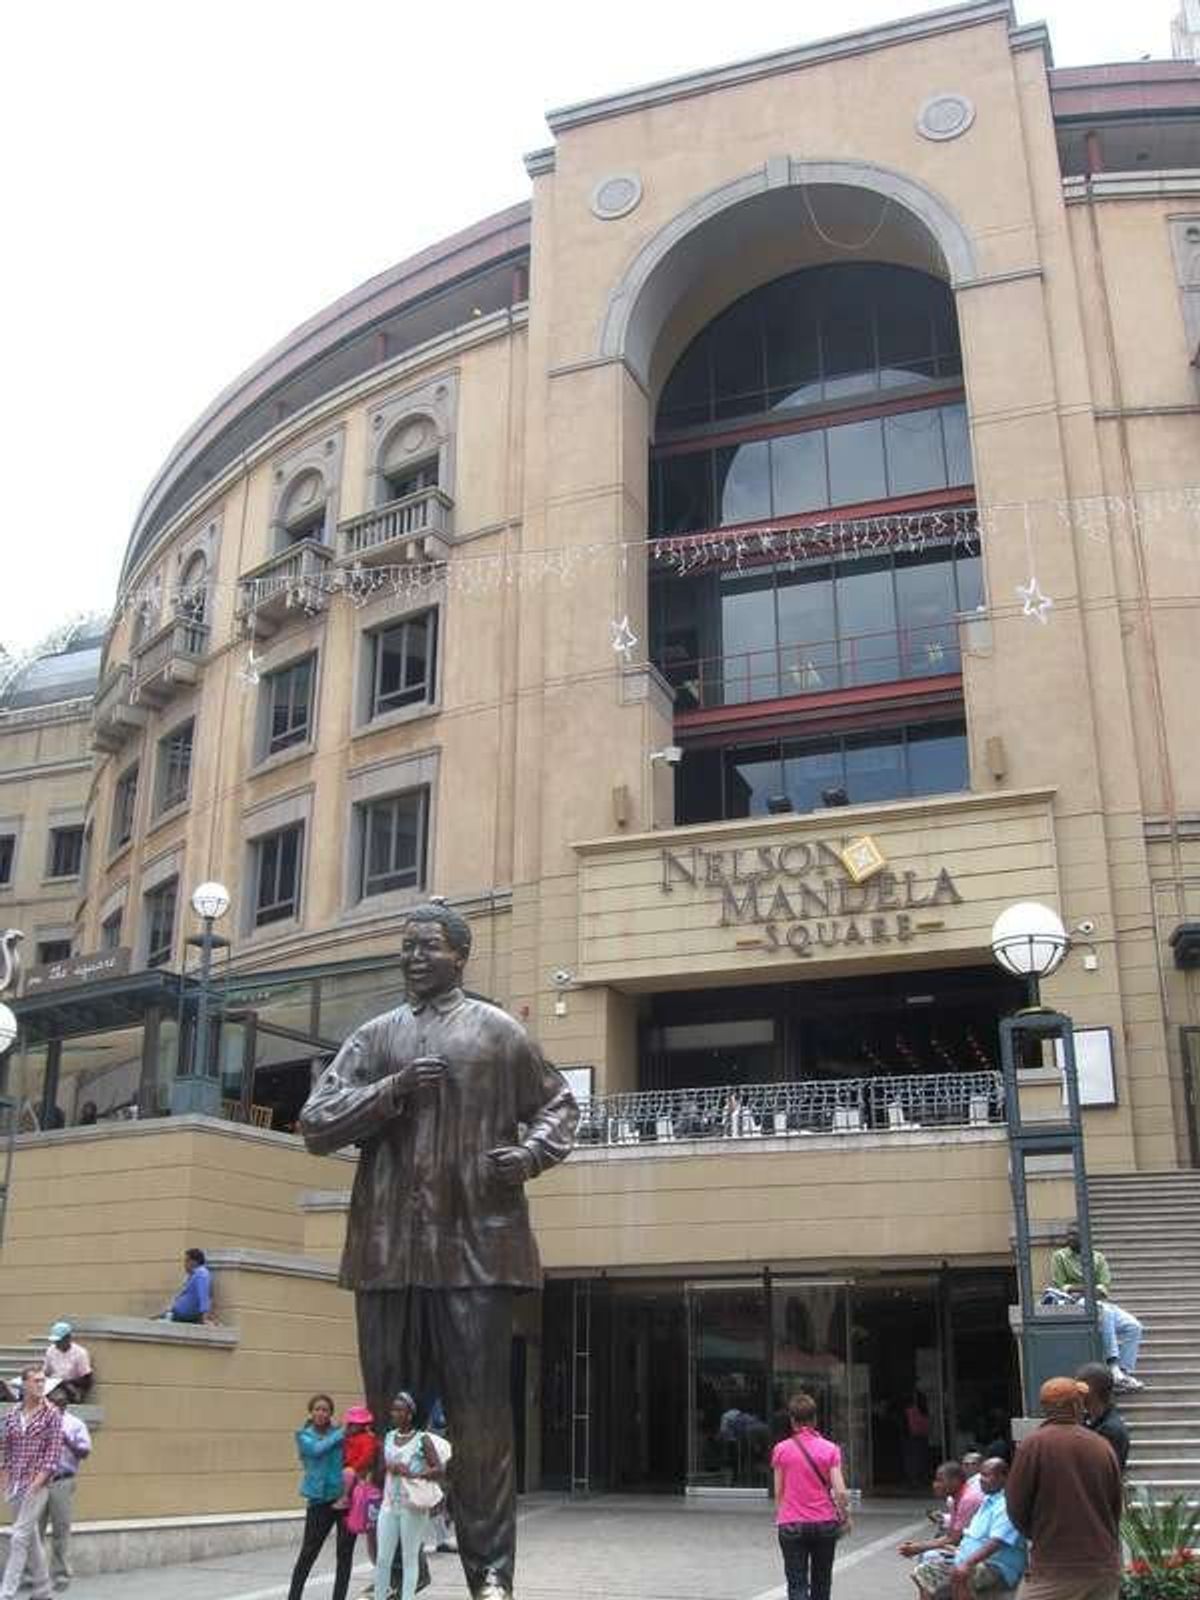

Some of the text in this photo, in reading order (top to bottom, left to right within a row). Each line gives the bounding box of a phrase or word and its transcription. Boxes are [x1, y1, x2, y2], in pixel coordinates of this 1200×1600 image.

[660, 837, 855, 894] NELSON
[719, 866, 964, 927] MANDELA
[763, 914, 914, 957] SQUARE
